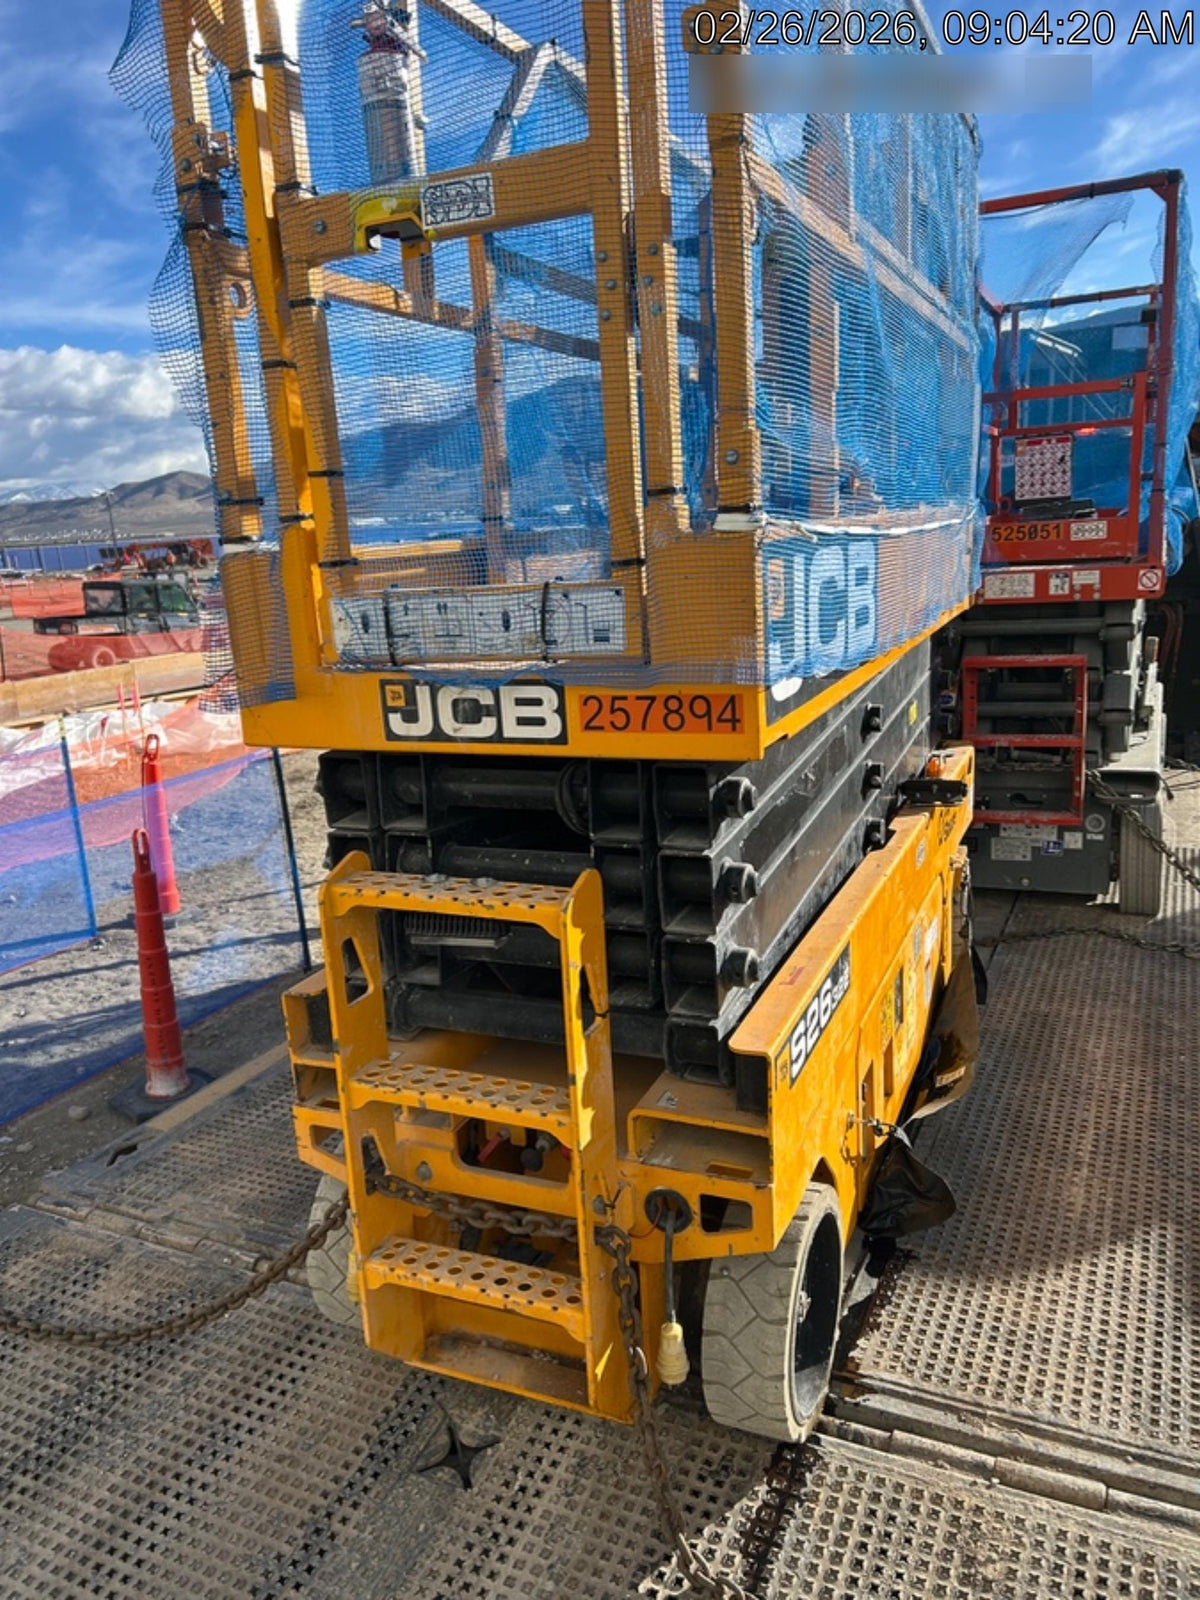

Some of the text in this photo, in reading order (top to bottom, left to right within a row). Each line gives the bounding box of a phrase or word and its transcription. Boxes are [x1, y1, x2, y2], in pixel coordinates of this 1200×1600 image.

[991, 523, 1061, 542] 525051
[387, 685, 563, 739] JCB
[582, 694, 742, 733] 257894
